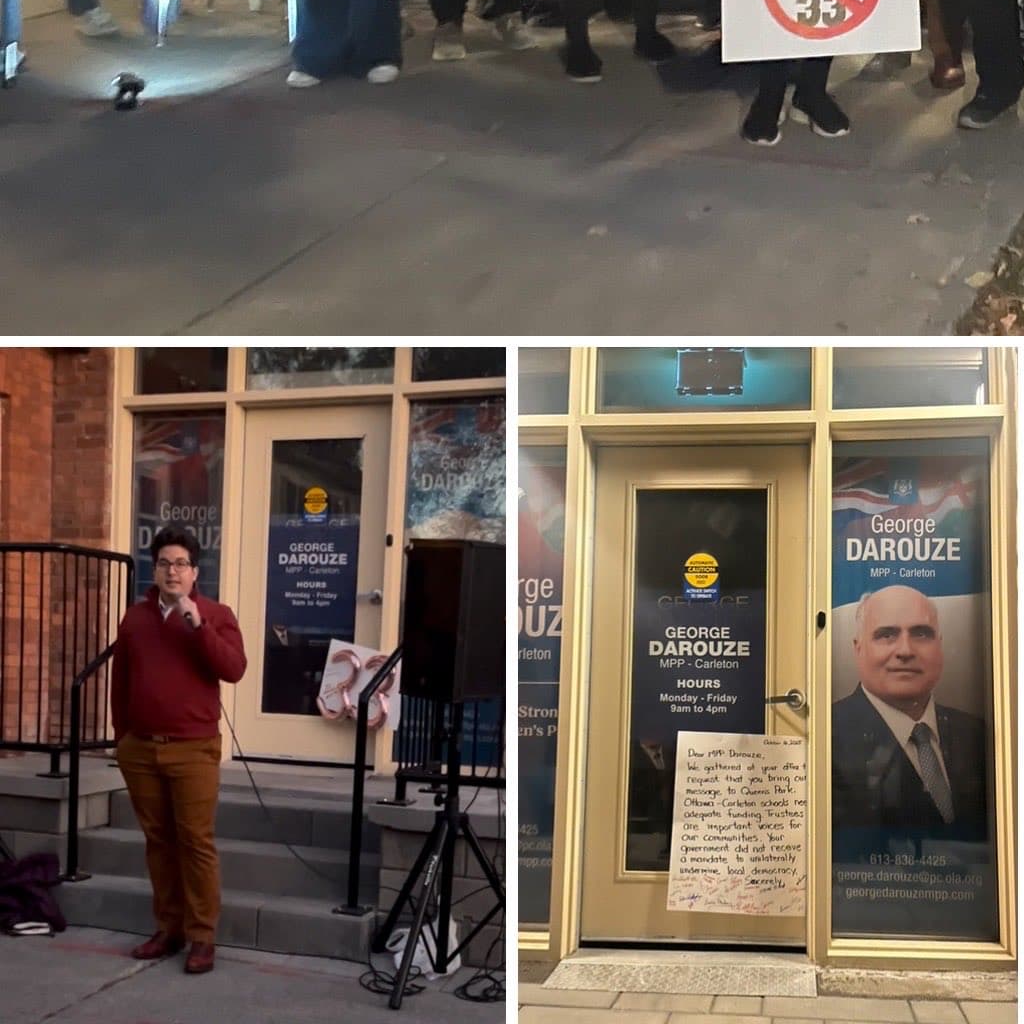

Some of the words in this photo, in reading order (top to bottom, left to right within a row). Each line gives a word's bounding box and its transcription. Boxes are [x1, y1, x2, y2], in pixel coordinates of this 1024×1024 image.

[160, 502, 217, 525] George
[871, 514, 936, 537] George
[289, 542, 335, 553] GEORGE
[846, 538, 961, 561] DAROUZE
[278, 553, 348, 565] DAROUZE
[870, 567, 890, 577] MPP
[899, 567, 936, 578] Carleton
[296, 581, 327, 589] HOURS
[518, 605, 564, 637] UZ
[665, 627, 730, 639] GEORGE
[649, 640, 750, 657] DAROUZE
[660, 659, 685, 668] MPP
[695, 658, 739, 669] Carleton
[677, 679, 721, 689] HOURS
[659, 693, 698, 705] Monday
[707, 693, 737, 705] Friday
[670, 705, 691, 713] 9am
[694, 705, 703, 713] to
[705, 705, 727, 714] 4pm
[704, 762, 741, 774] gathered
[761, 765, 777, 775] your
[726, 775, 743, 783] that
[749, 777, 763, 785] you
[768, 774, 790, 786] bring
[728, 786, 736, 795] to
[767, 809, 803, 817] Trustees
[683, 823, 699, 833] are
[707, 823, 751, 834] important
[790, 819, 801, 829] for
[767, 833, 784, 841] Your
[680, 844, 729, 855] government
[735, 844, 749, 853] did
[752, 844, 765, 852] not
[690, 855, 728, 864] mandate
[736, 854, 744, 863] to
[727, 865, 745, 875] local
